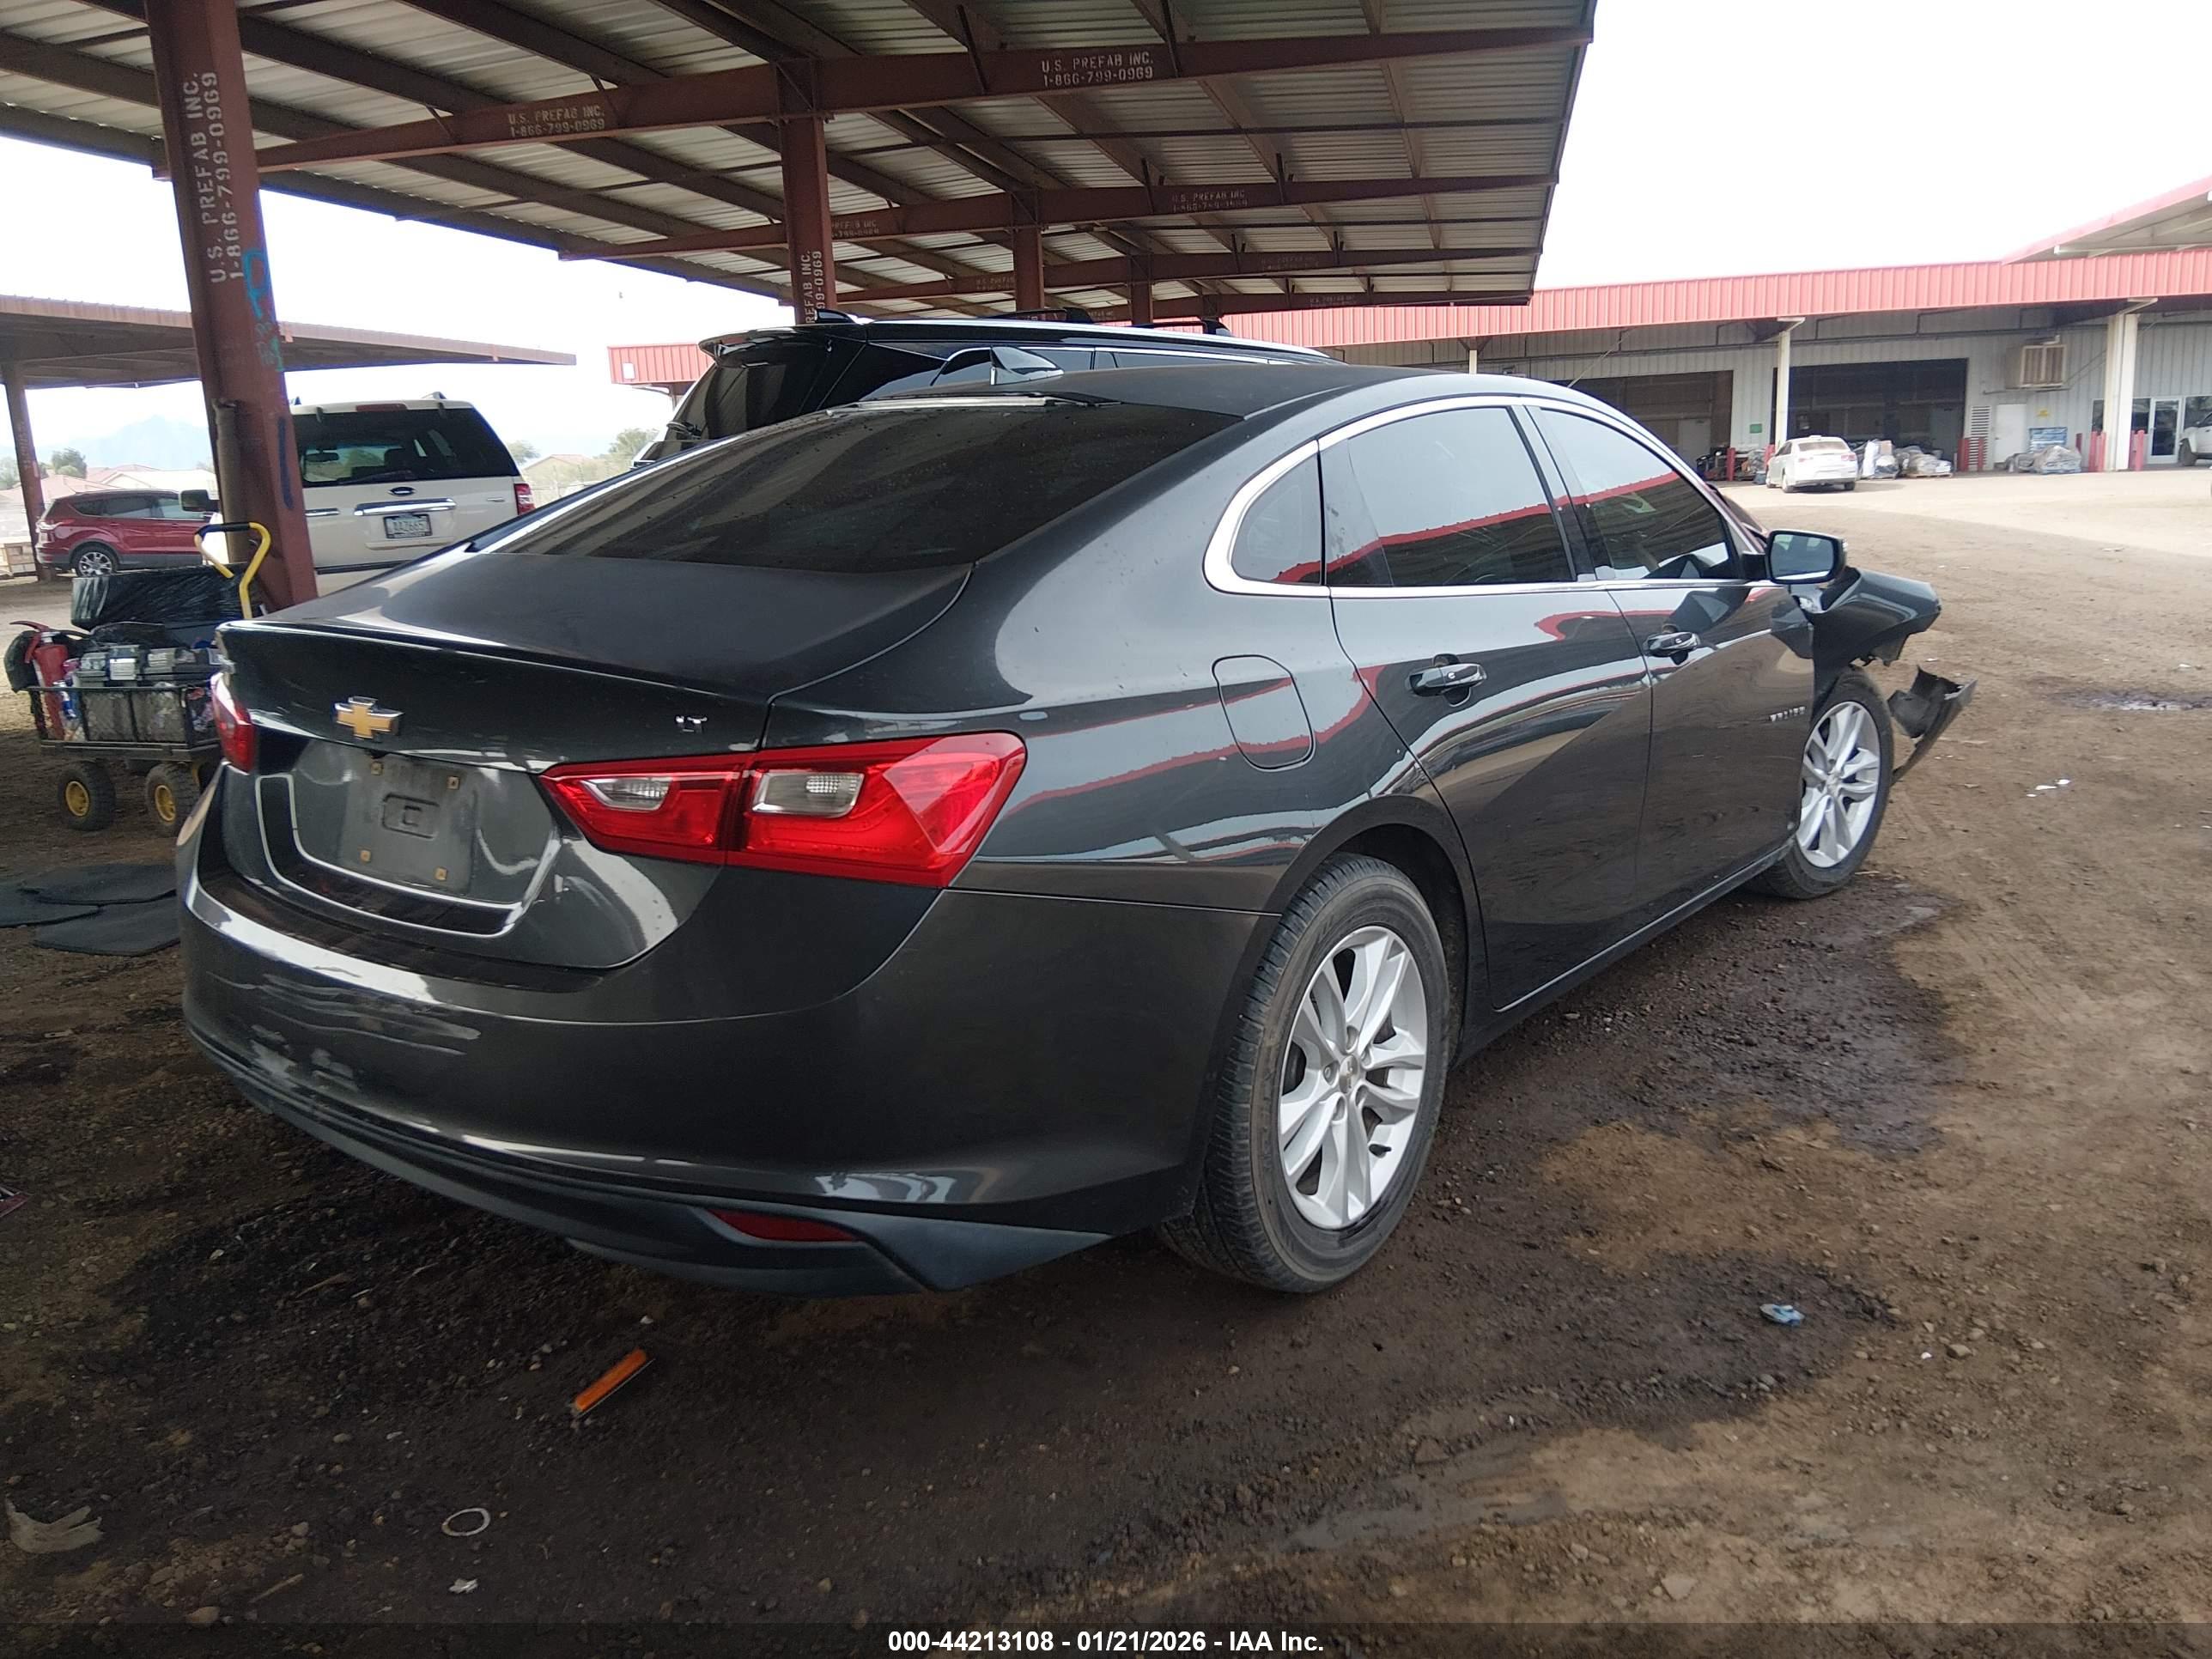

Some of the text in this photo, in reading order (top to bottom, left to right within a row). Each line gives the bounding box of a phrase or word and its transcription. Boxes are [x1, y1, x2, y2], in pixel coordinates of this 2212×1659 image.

[1043, 65, 1154, 88] 1-866-799-0969
[1073, 53, 1122, 70] PREFAB
[1129, 51, 1154, 66] INC.
[507, 104, 605, 125] U.S. PREFAB INC.
[509, 118, 605, 137] 1-866-799-0969
[183, 72, 228, 283] U.S. PREFAB INC.
[201, 71, 245, 280] 1-866-799-0969
[800, 250, 816, 324] REFAB INC.
[811, 250, 825, 310] 99-0969
